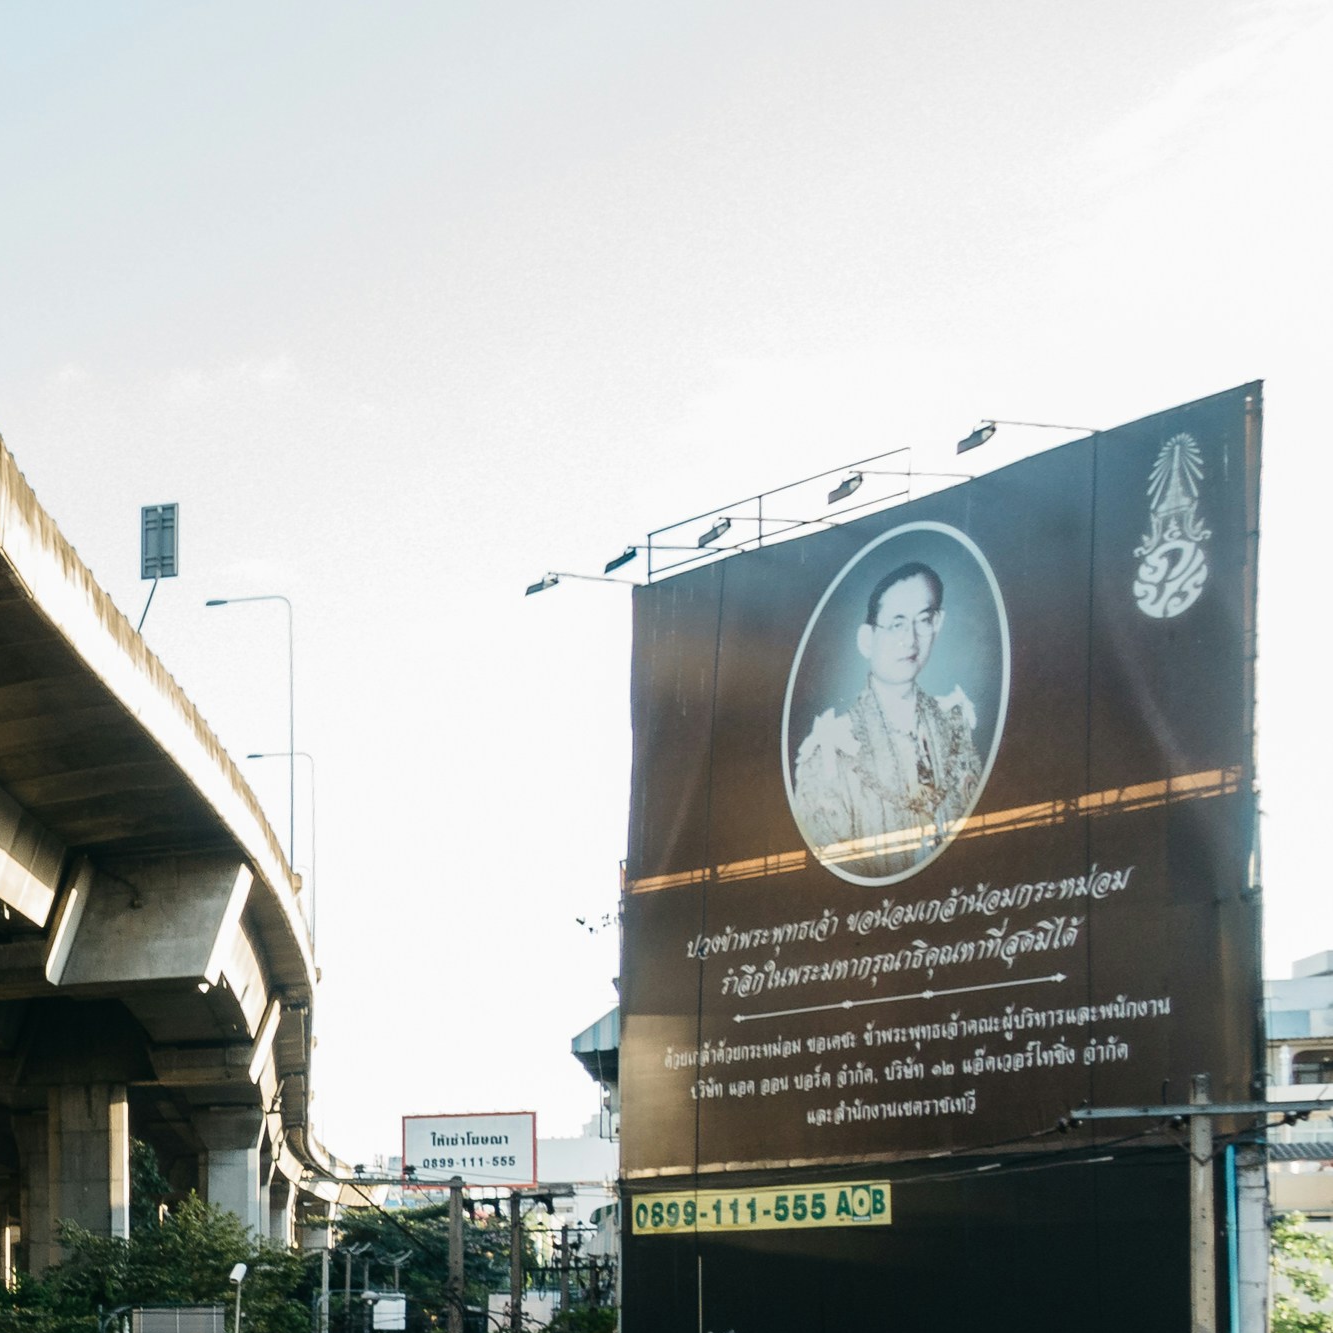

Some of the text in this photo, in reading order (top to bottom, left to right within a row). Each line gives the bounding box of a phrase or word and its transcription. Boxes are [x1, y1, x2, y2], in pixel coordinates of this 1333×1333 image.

[1083, 1035, 1129, 1066] จำกัด
[423, 1155, 516, 1169] 0899-111-555
[635, 1193, 826, 1229] 0899-111-555
